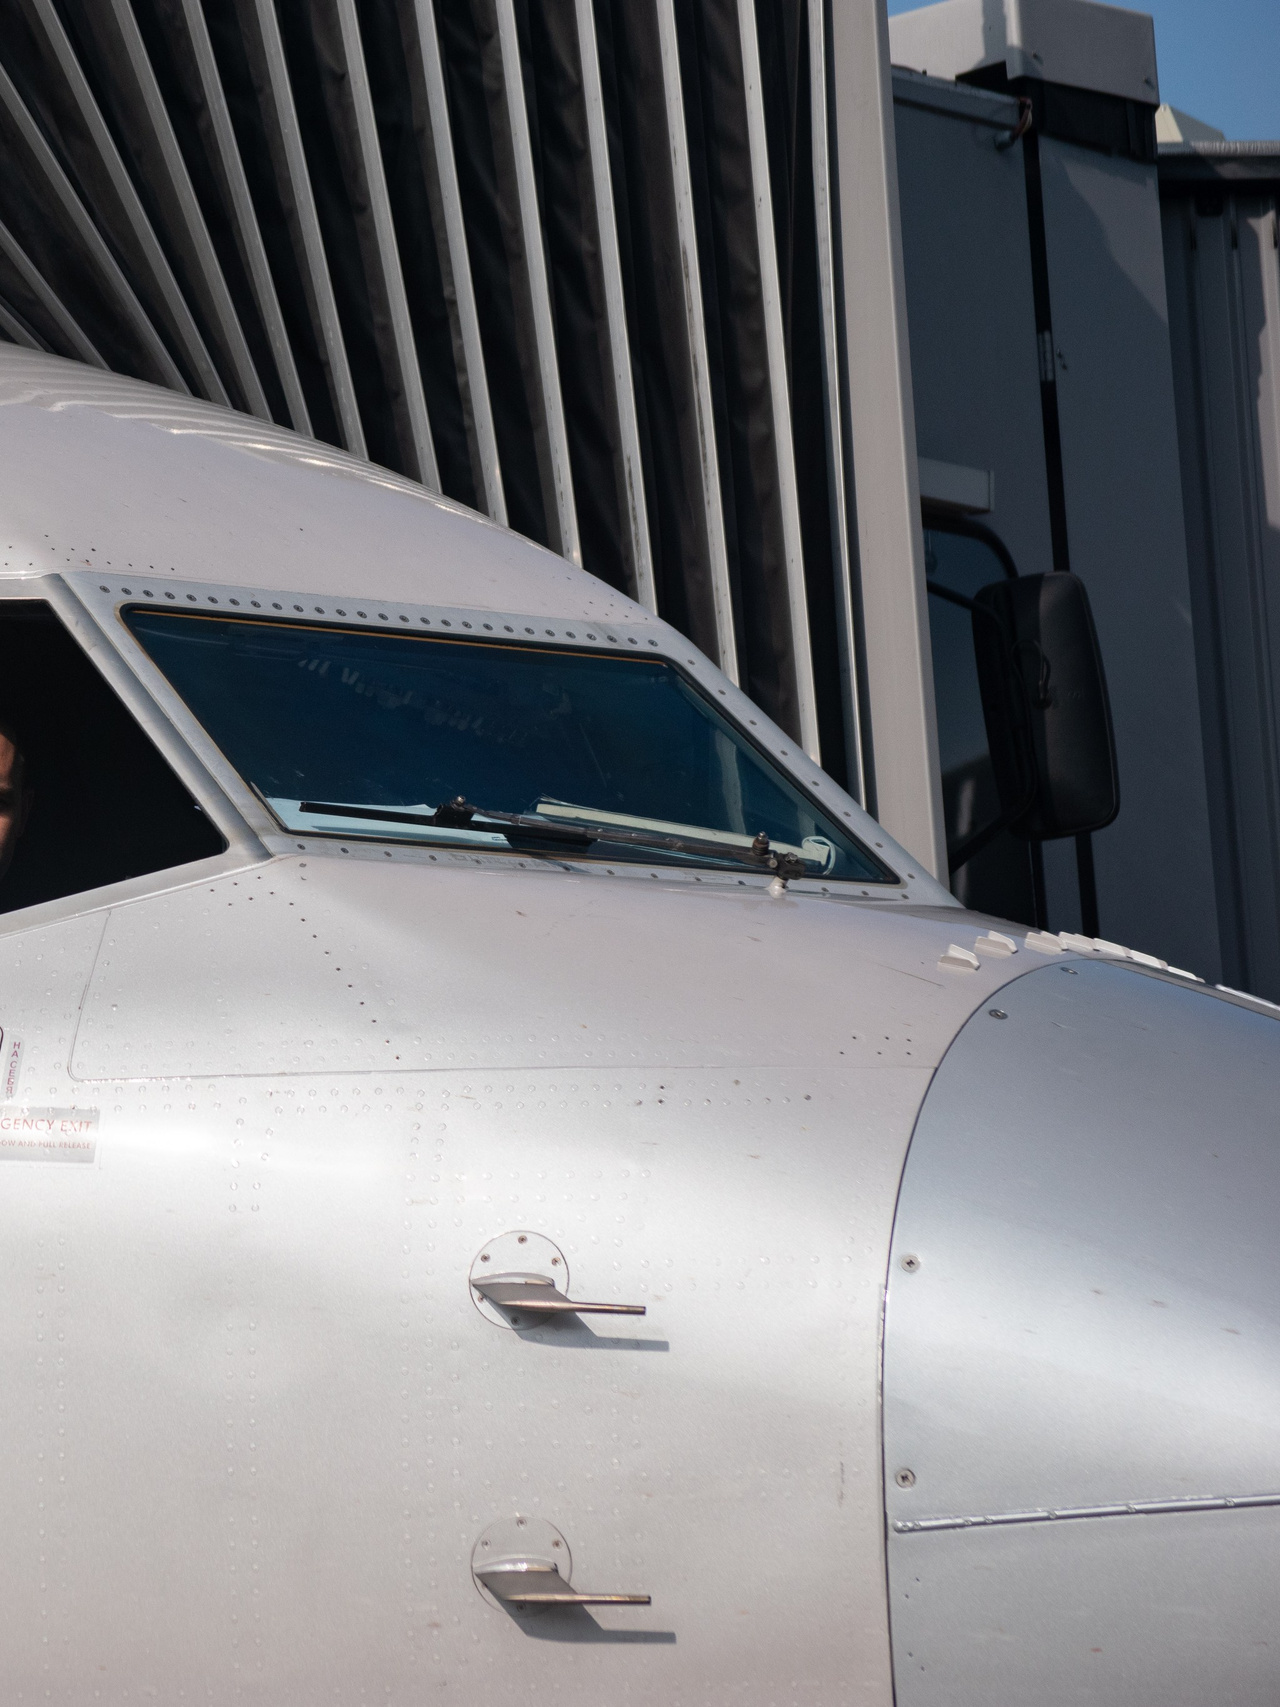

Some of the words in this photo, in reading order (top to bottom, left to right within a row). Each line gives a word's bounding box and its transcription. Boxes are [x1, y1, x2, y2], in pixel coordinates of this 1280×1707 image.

[60, 1119, 92, 1133] EXIT
[38, 1141, 56, 1149] PULL
[58, 1142, 91, 1150] RELEASE
